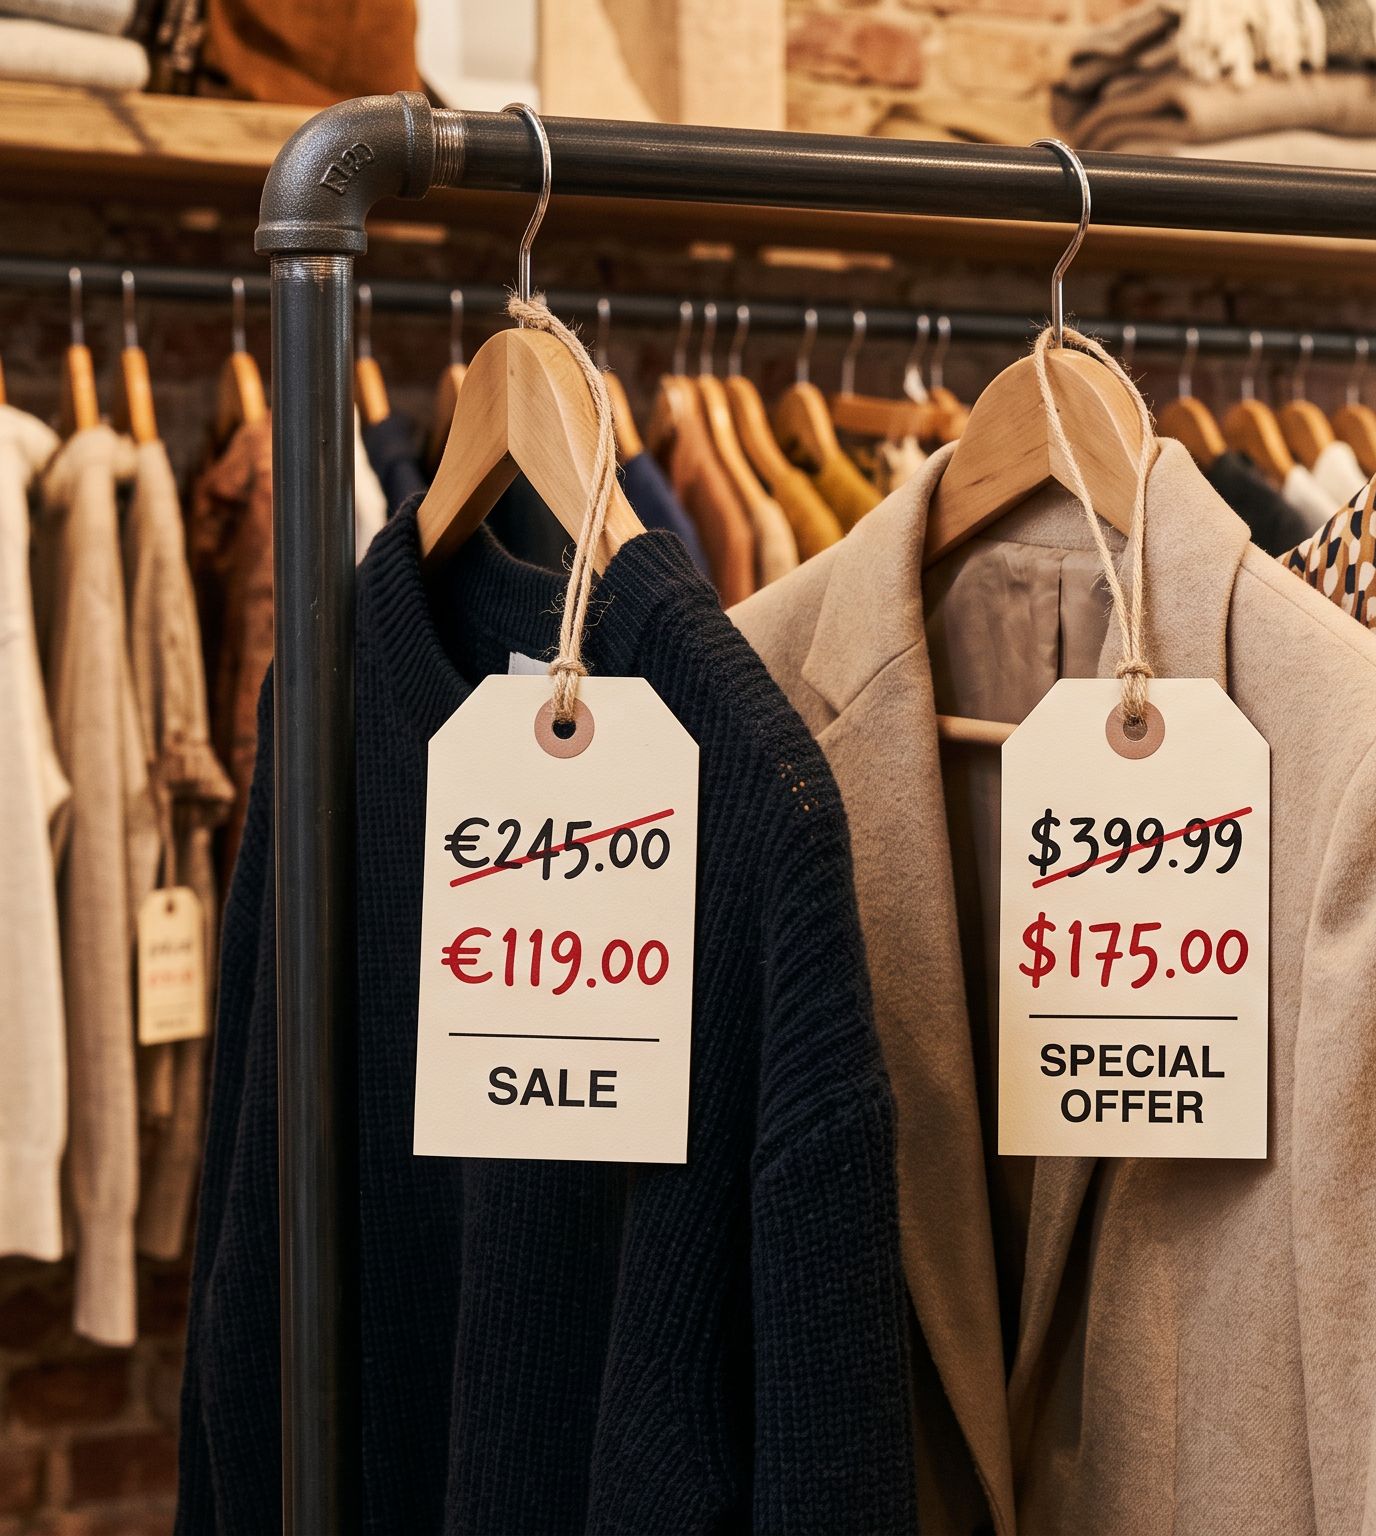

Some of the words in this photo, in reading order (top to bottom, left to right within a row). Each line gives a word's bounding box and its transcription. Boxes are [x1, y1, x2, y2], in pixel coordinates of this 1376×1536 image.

[444, 817, 671, 881] €245.00
[1028, 808, 1243, 878] $399.99
[440, 926, 670, 996] €119.00
[1018, 911, 1249, 990] $175.00
[487, 1066, 618, 1109] SALE
[1040, 1043, 1225, 1078] SPECIAL
[1060, 1088, 1204, 1124] OFFER
